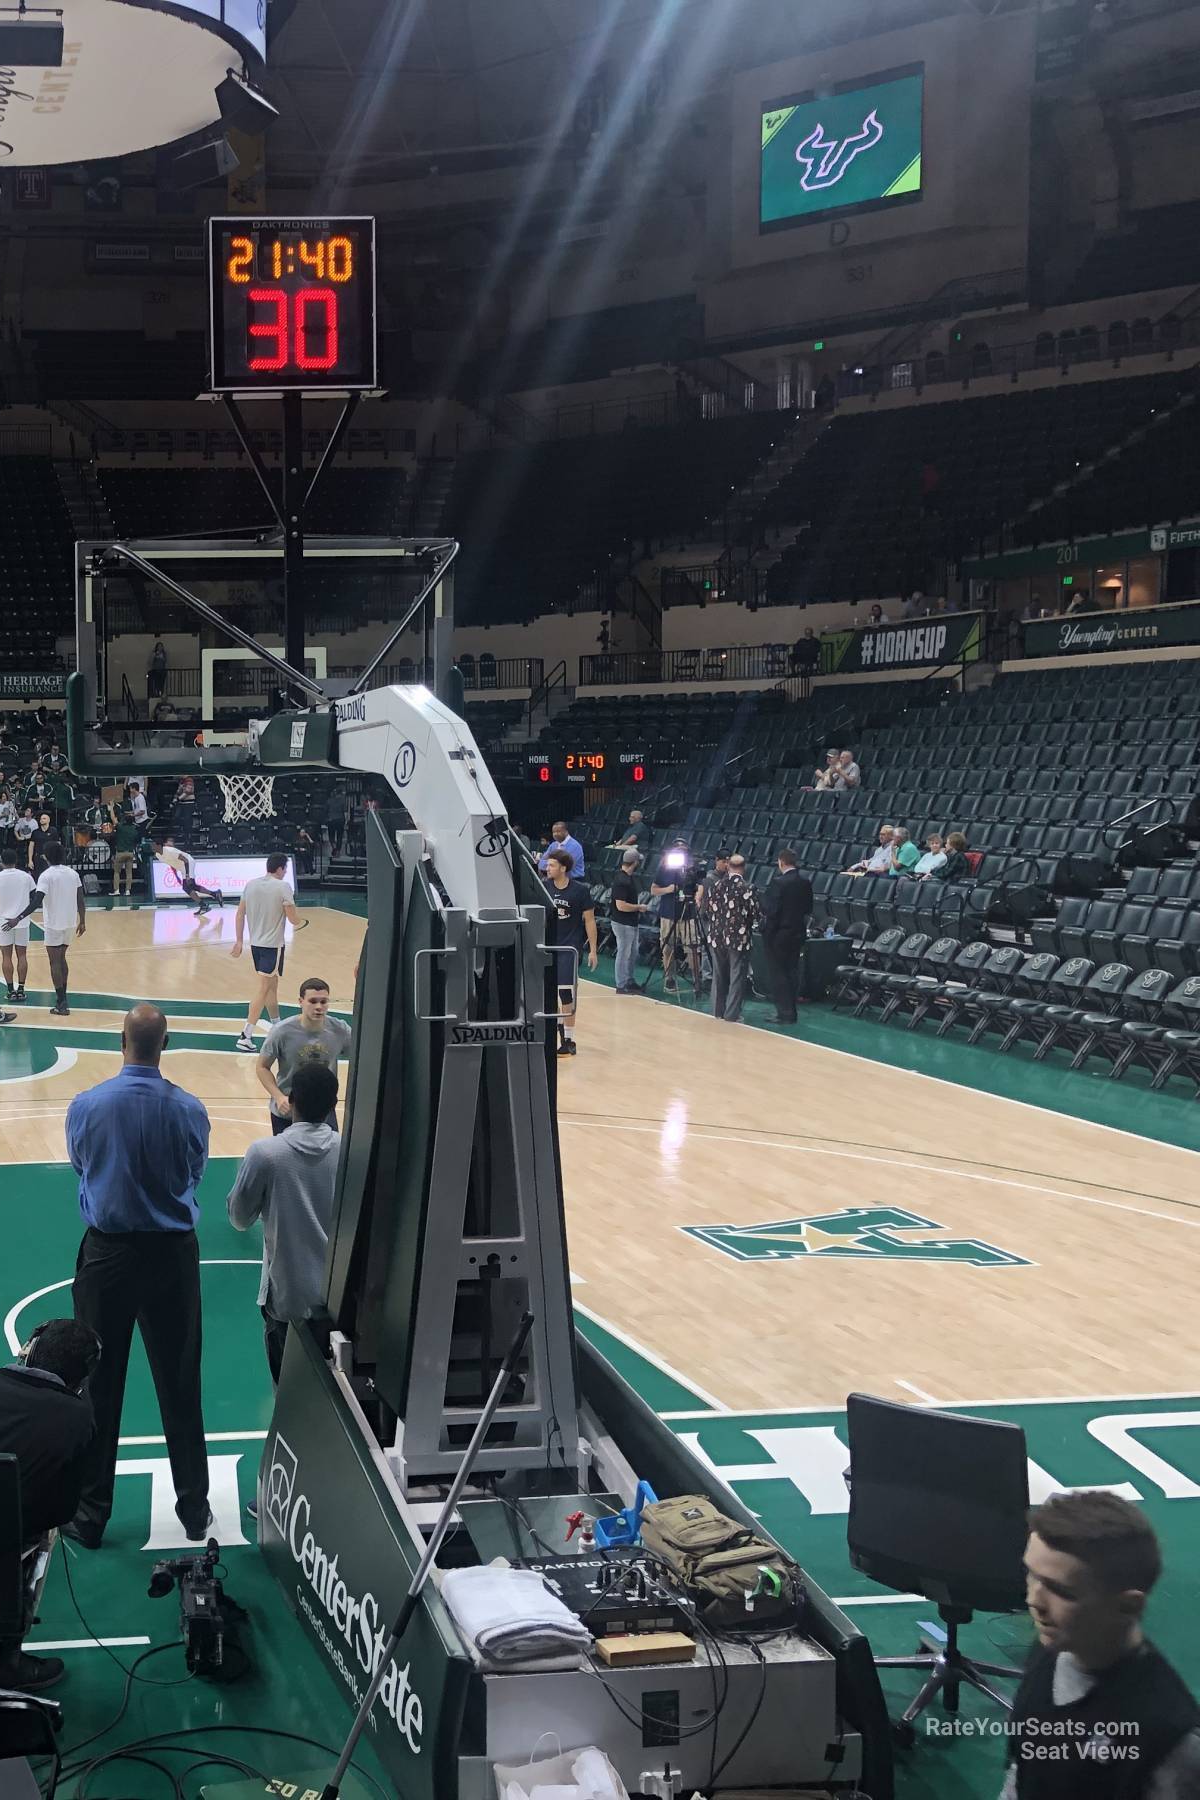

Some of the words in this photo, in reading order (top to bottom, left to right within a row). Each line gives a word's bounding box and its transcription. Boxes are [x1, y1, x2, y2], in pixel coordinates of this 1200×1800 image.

[253, 221, 330, 229] DAKTRONICS
[228, 236, 352, 283] 21:40
[248, 289, 338, 370] 30
[1057, 545, 1079, 563] 201
[1059, 622, 1117, 649] Yuengling
[1118, 625, 1158, 639] CENTER
[3, 676, 63, 686] HERITAGE
[3, 685, 63, 693] INSURANCE
[335, 695, 366, 723] PALDING
[529, 755, 550, 764] HOME
[566, 755, 604, 769] 21:40
[539, 767, 550, 782] 0
[634, 766, 644, 781] 0
[452, 1025, 535, 1044] SPALDING
[530, 1559, 647, 1571] DAKTROICS
[290, 1494, 423, 1754] CenterState
[296, 1585, 378, 1733] CenterStateBank.cm
